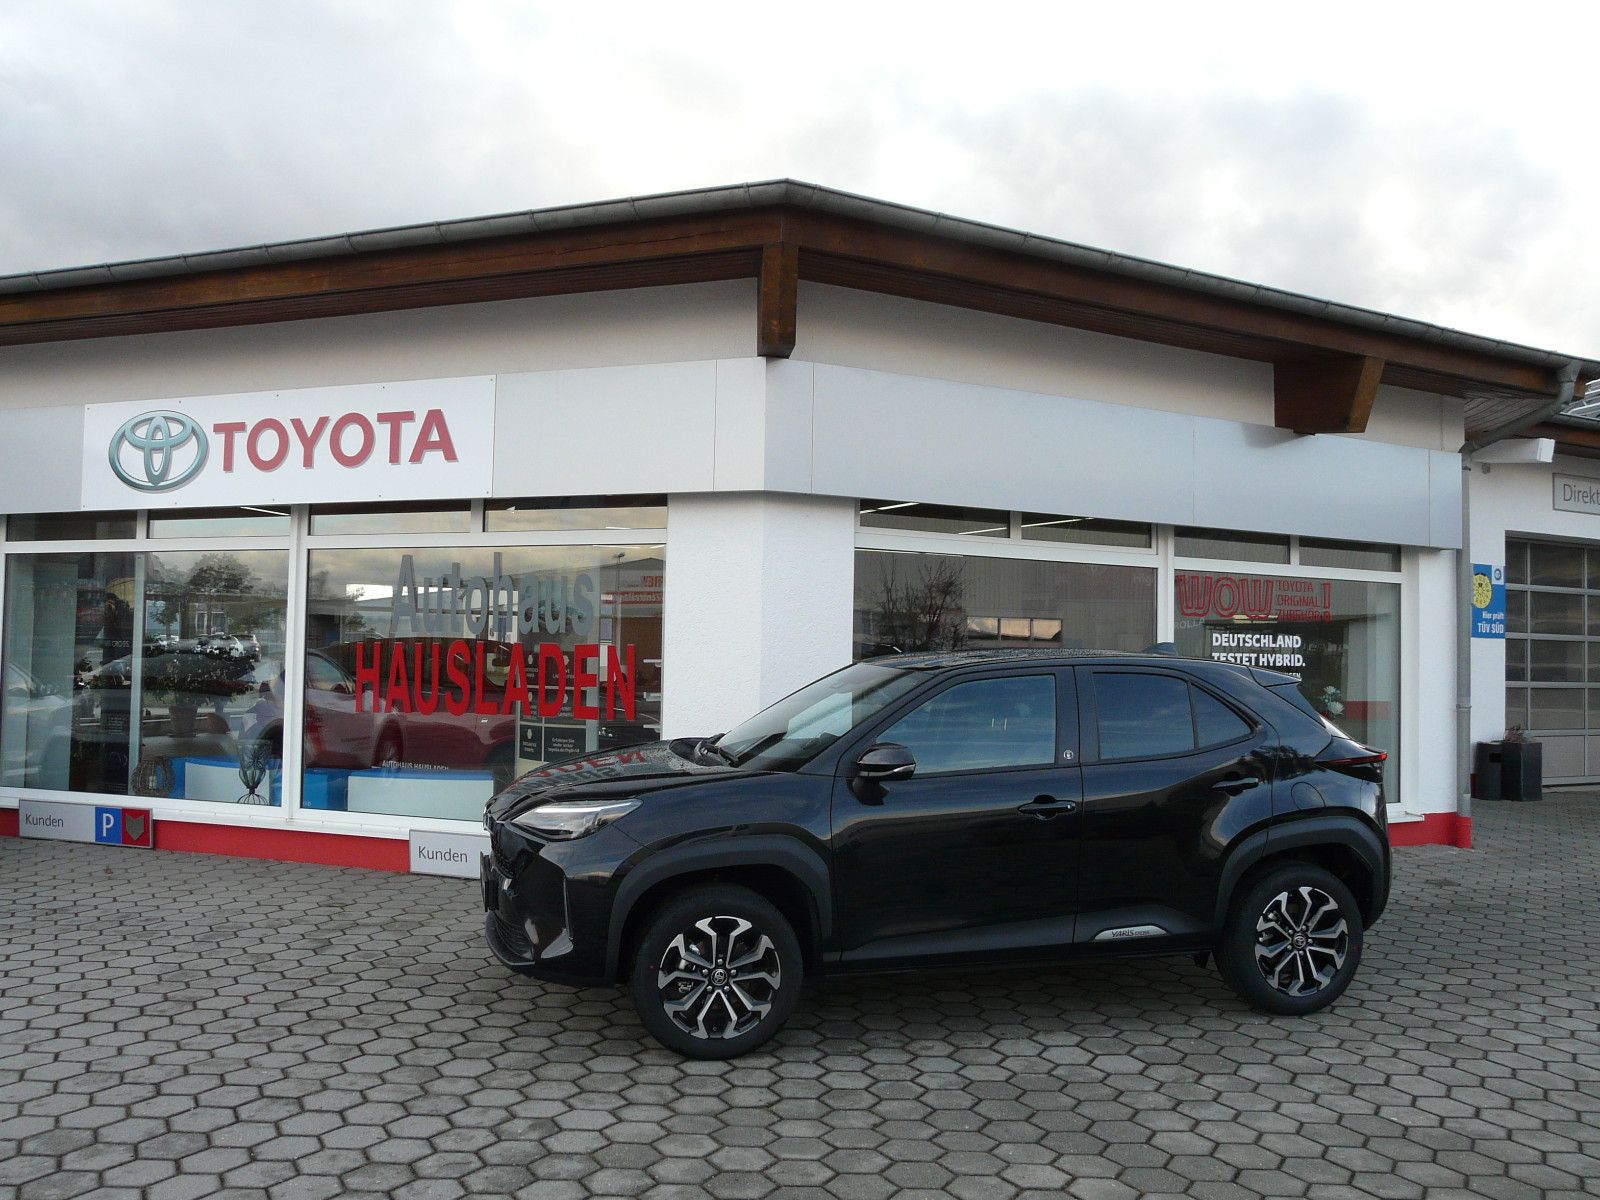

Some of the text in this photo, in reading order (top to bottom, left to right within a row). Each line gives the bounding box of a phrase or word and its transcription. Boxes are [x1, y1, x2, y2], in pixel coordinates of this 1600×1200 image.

[213, 409, 458, 472] TOYOTA
[1563, 484, 1600, 505] Direkt
[390, 552, 595, 635] Autohaus
[1278, 580, 1314, 592] TOYOTA
[1277, 594, 1320, 607] ORIGINAL
[1478, 621, 1504, 634] TÜV SÜD
[1212, 633, 1302, 648] DEUTSCHLAND
[1212, 652, 1306, 667] TESTET HYBRID.
[355, 639, 636, 720] HAUSLADEN
[382, 760, 413, 769] AUTOHAUS
[25, 813, 115, 837] Kunden P
[418, 845, 468, 863] Kunden
[1111, 928, 1134, 938] YARIS
